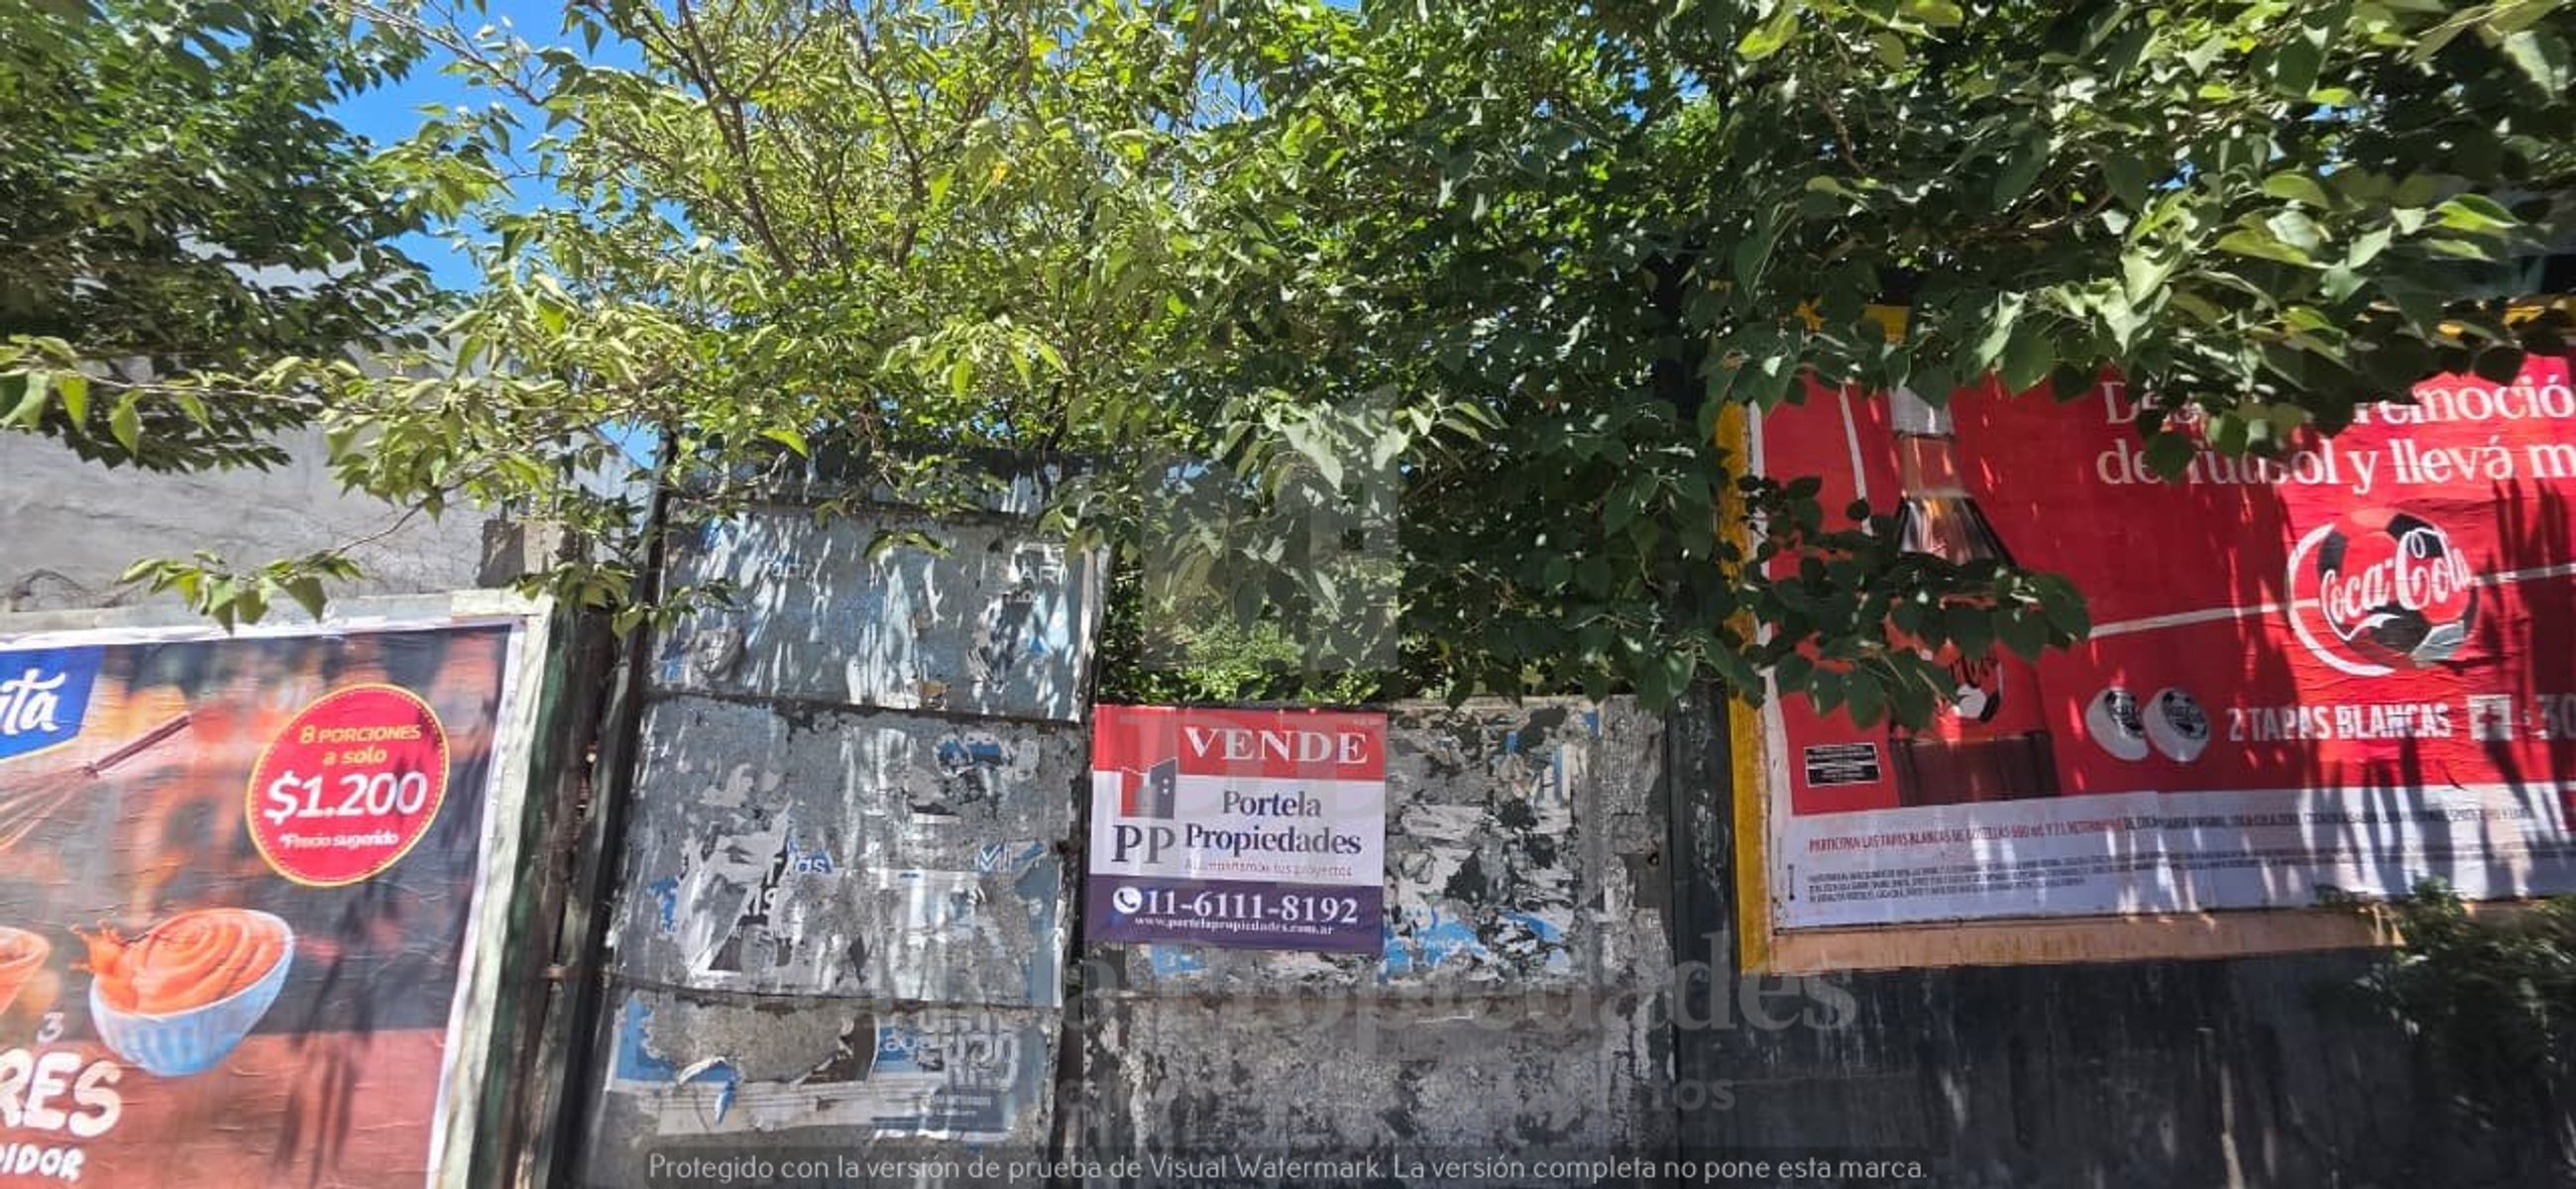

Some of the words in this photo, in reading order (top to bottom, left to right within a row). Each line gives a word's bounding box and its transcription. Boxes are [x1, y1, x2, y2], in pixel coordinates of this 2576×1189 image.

[2347, 450, 2379, 493] y
[2389, 434, 2515, 485] llevá
[2321, 527, 2473, 640] Coca-Cola
[300, 724, 315, 744] 8
[318, 724, 421, 743] PORCIONES
[2228, 707, 2245, 741] 2
[2249, 705, 2329, 741] TAPAS
[2334, 702, 2452, 740] BLANCAS
[322, 751, 336, 766] a
[341, 745, 388, 765] solo
[1184, 726, 1369, 765] VENDE
[264, 770, 428, 825] $1.200
[1223, 791, 1321, 818] Portela
[332, 828, 399, 850] sugerido
[1111, 824, 1176, 865] PP
[1184, 822, 1363, 858] Propiedades
[1147, 889, 1358, 924] 11-6111-8192
[1135, 914, 1335, 936] www.portelapropiedades.com.ar
[37, 1012, 64, 1041] 3
[0, 1142, 86, 1182] IDOR
